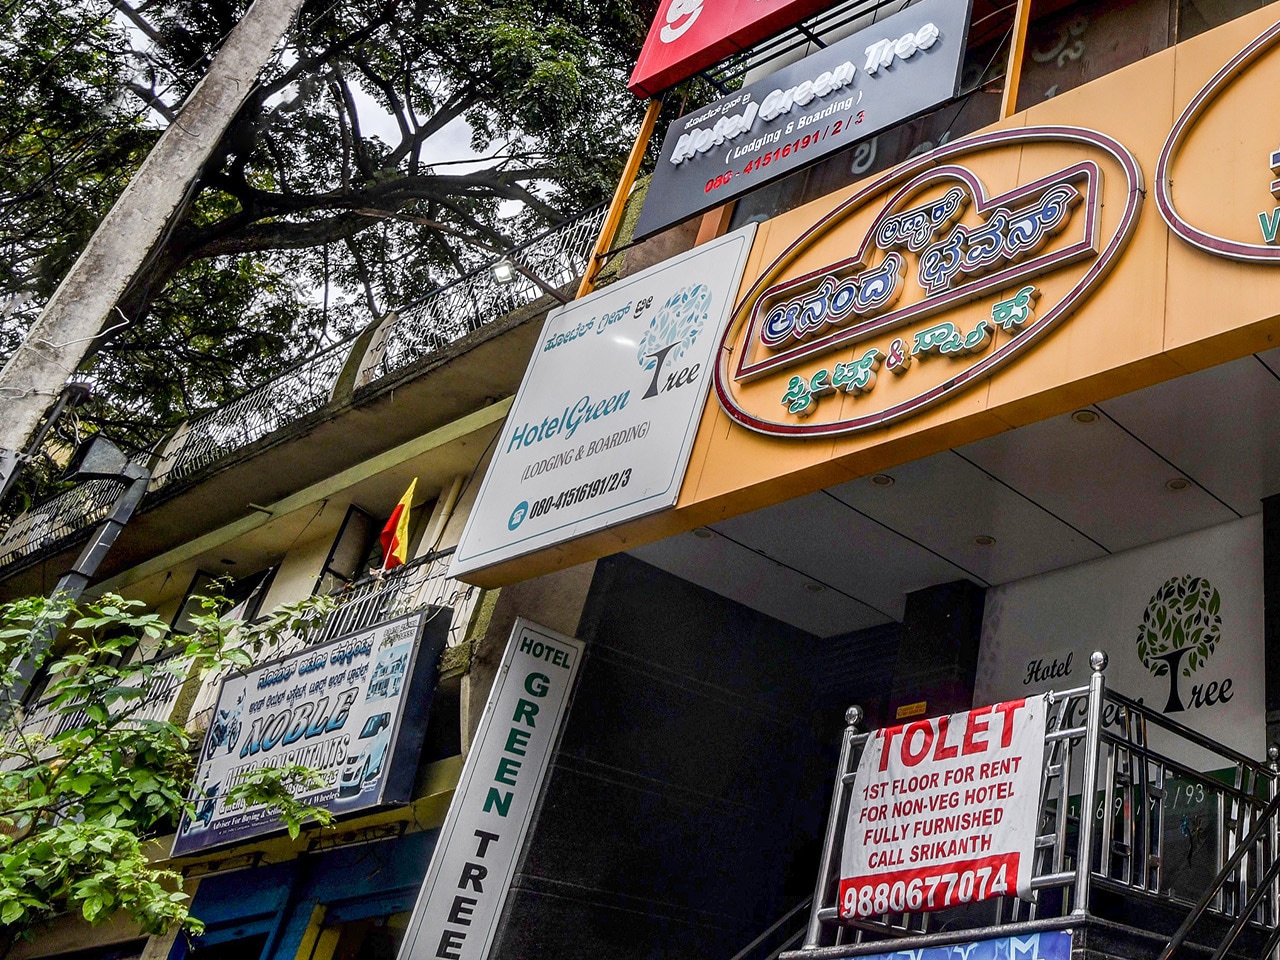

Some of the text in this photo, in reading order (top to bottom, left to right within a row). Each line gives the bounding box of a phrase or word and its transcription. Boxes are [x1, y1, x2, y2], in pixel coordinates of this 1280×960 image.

[669, 21, 942, 168] Hotel Green Tree
[733, 128, 783, 161] Lodging
[784, 119, 796, 137] &
[796, 98, 855, 133] Boarding
[885, 338, 905, 371] &
[506, 340, 701, 454] Hotel Green Tree
[574, 444, 585, 462] &
[528, 467, 633, 520] 080-41516191/2/3
[519, 636, 571, 670] HOTEL
[1022, 651, 1074, 686] Hotel
[1150, 645, 1235, 714] Tree
[239, 686, 360, 759] NOBLE
[482, 671, 551, 818] GREEN
[859, 804, 888, 824] FOR
[891, 793, 960, 819] NON-VEG
[964, 781, 1015, 806] HOTEL
[862, 756, 1023, 801] 1ST FLOOR FOR RENT
[862, 807, 1004, 846] FULLY FURNISHED
[868, 833, 993, 869] CALL SRIKANTH
[435, 829, 500, 960] TREE
[842, 863, 1009, 920] 9880677074
